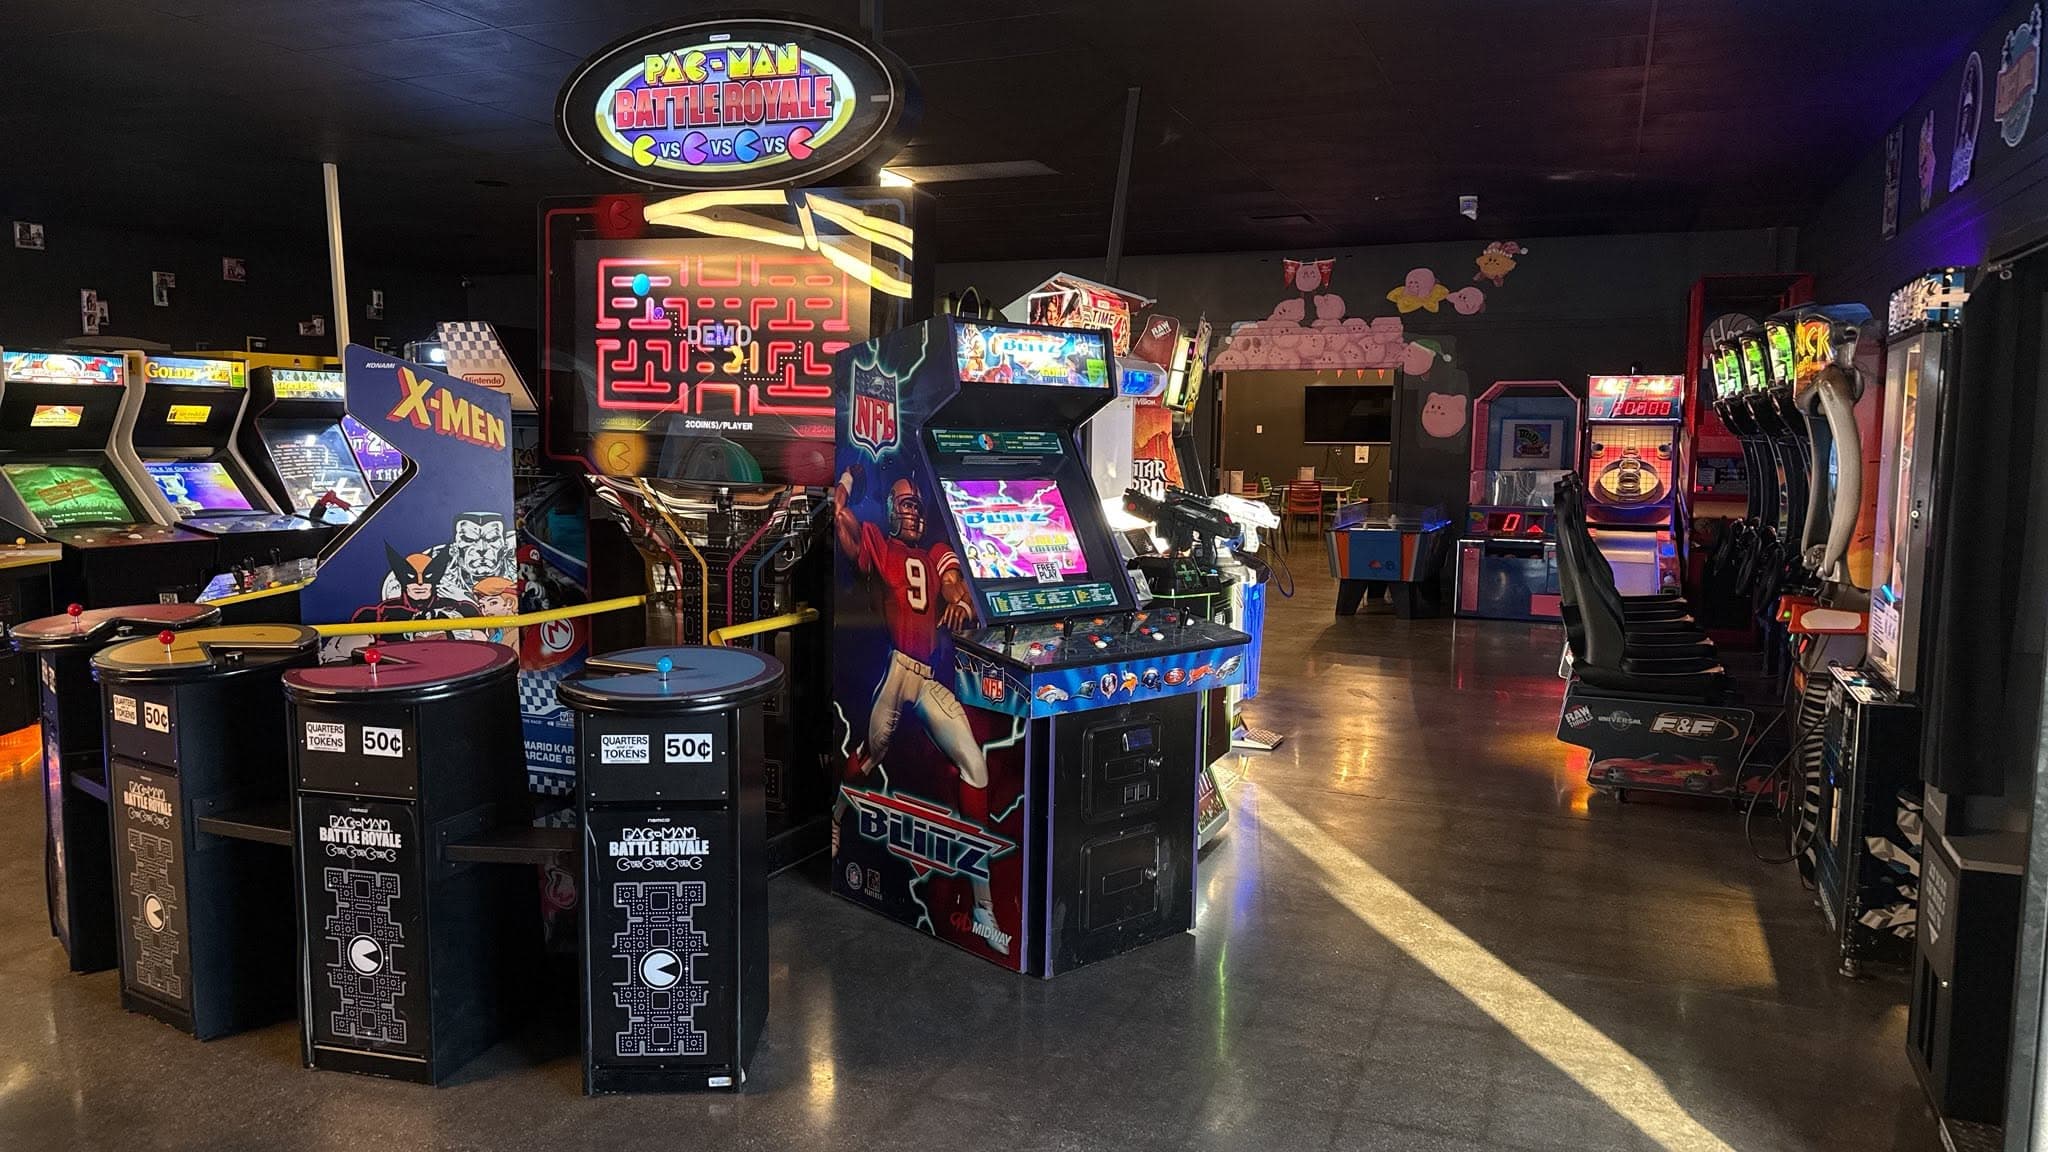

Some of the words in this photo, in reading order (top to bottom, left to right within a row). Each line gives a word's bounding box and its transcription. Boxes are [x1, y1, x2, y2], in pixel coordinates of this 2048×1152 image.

[644, 43, 801, 85] PAC-MAN
[615, 83, 720, 131] BATTLE
[722, 75, 833, 124] ROYALE
[659, 142, 680, 158] VS
[710, 140, 732, 156] VS
[763, 138, 785, 154] VS
[1092, 309, 1115, 326] TIME
[687, 325, 753, 346] DEMO
[1152, 321, 1170, 336] RAW
[464, 376, 502, 385] Nintendo
[387, 366, 507, 450] X-MEN
[684, 419, 753, 431] 2COIN(S)/PLAYER
[854, 395, 896, 444] NFL
[1134, 459, 1168, 481] TAR
[965, 512, 1049, 527] BLITZ
[1502, 514, 1520, 531] 0
[1025, 534, 1069, 546] GOLD
[1036, 563, 1056, 572] FREE
[1040, 571, 1058, 580] PLAY
[905, 558, 928, 614] 9
[982, 676, 1003, 698] NFL
[146, 707, 168, 728] 50¢
[1565, 705, 1590, 723] RAW
[307, 723, 344, 734] QUARTERS
[1652, 717, 1717, 734] F&F
[309, 736, 344, 747] TOKENS
[364, 731, 401, 754] 50¢
[524, 741, 552, 753] MARIO
[554, 744, 575, 754] KAR
[602, 736, 648, 746] QUARTERS
[667, 738, 711, 759] 50¢
[604, 749, 647, 758] TOKENS
[129, 780, 166, 802] PAC-MAN
[123, 791, 148, 810] BATTLE
[148, 797, 173, 817] ROYALE
[329, 815, 391, 832] PAC-MAN
[319, 827, 360, 845] BATTLE
[361, 831, 402, 848] ROYALE
[622, 827, 697, 841] PAC-MAN
[858, 802, 992, 879] BLITZ
[609, 841, 660, 856] BATTLE
[661, 840, 710, 855] ROYALE
[972, 921, 1013, 946] MIDWAY
